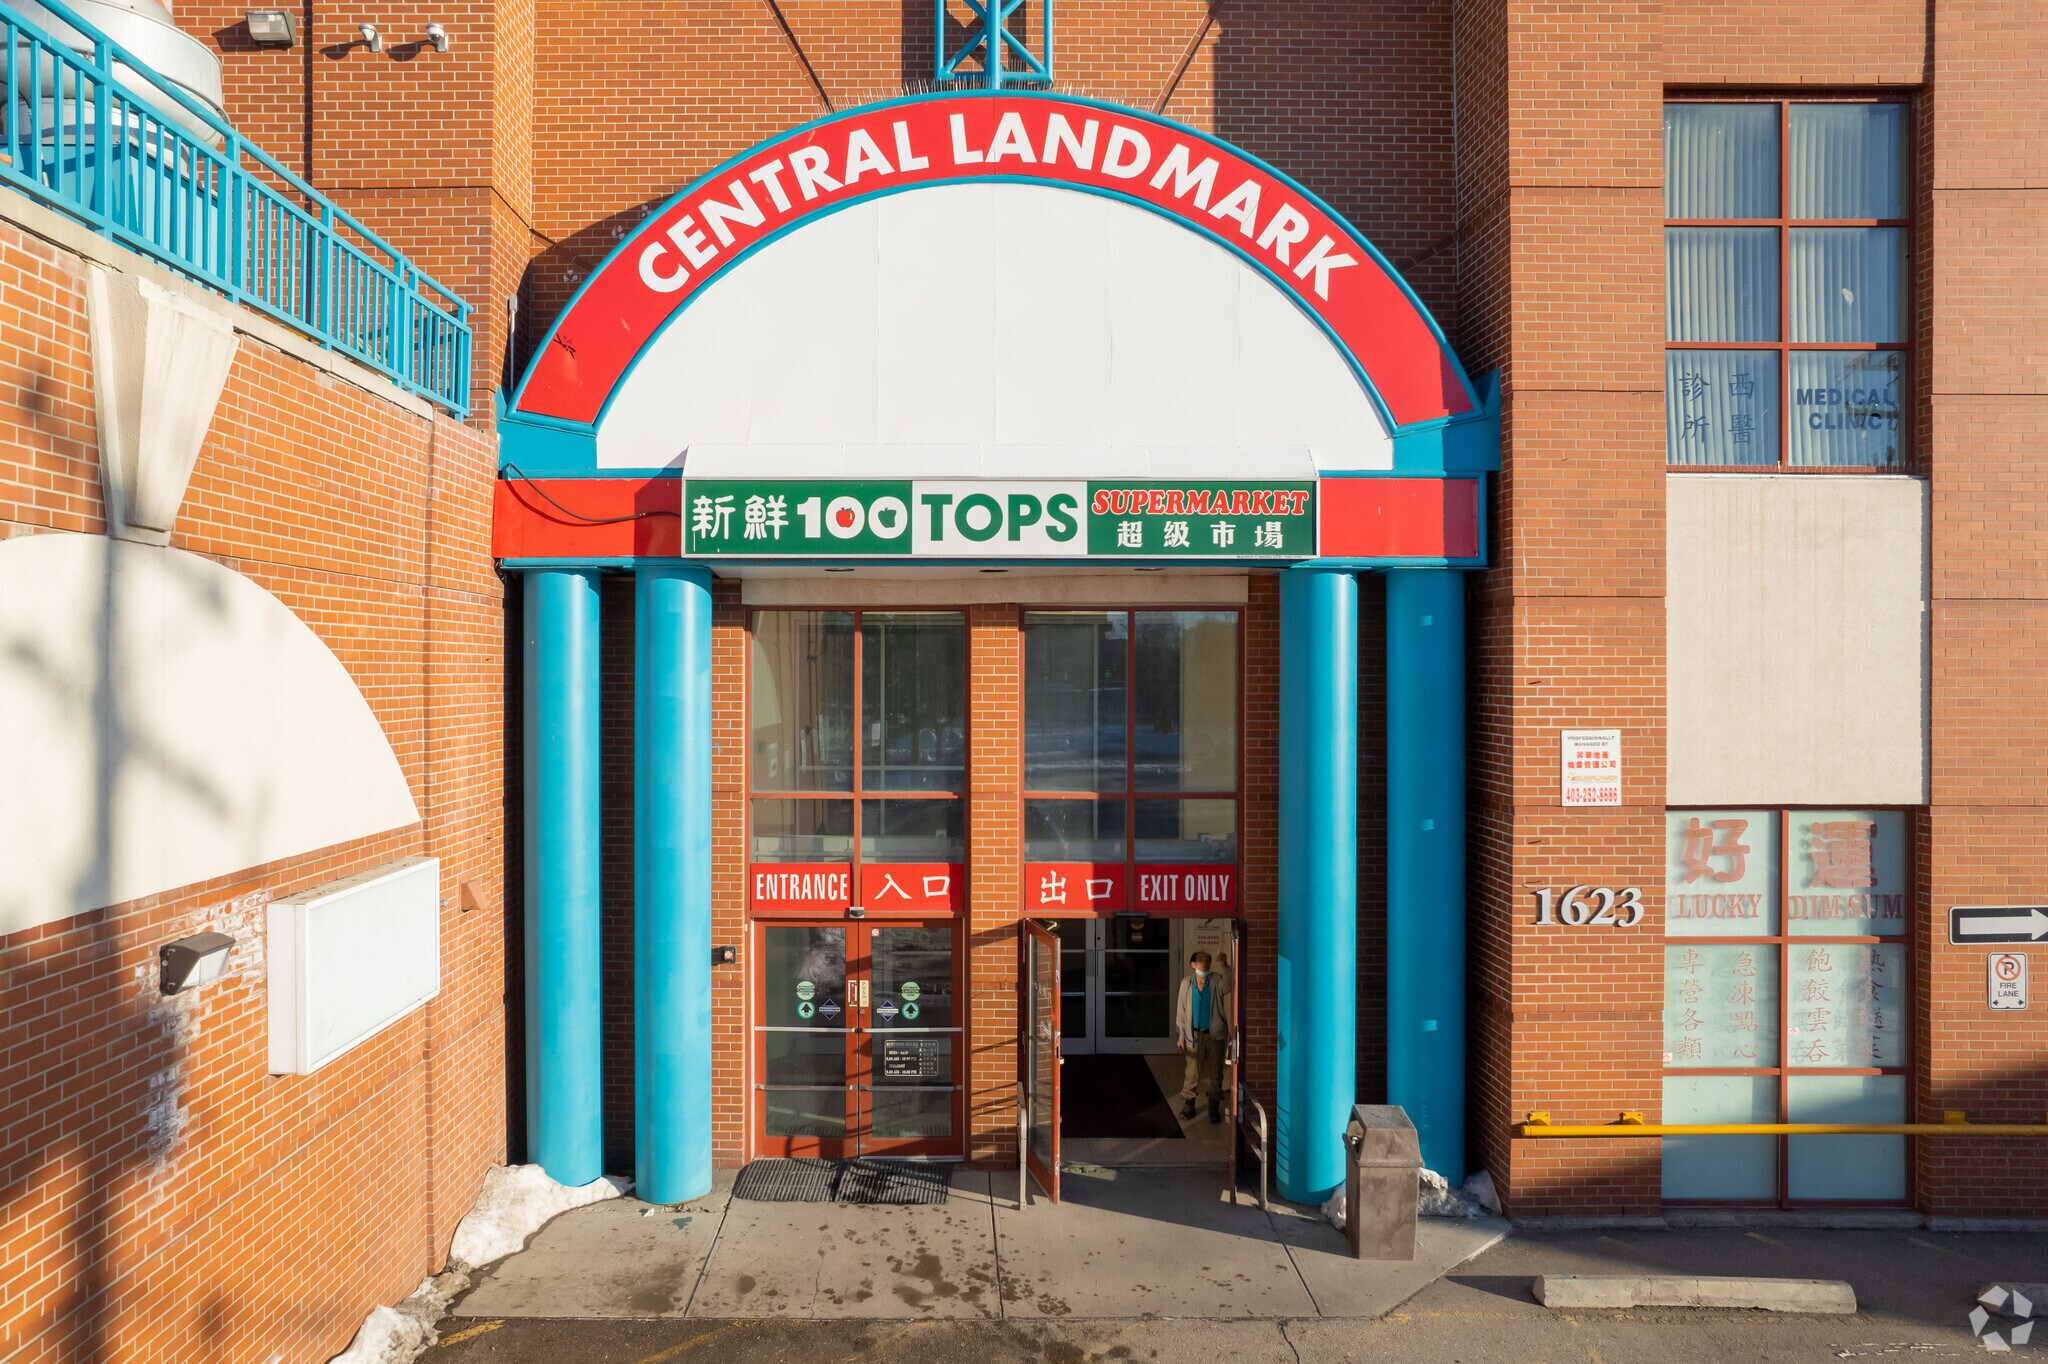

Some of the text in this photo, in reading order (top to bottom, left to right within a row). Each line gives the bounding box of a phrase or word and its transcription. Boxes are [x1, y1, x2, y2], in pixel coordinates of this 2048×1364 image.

[638, 110, 1359, 302] CENTRAL LANDMARK
[1678, 371, 1711, 444] 診所
[1727, 371, 1756, 445] 西醫
[1796, 388, 1896, 406] MEDICAL
[1808, 412, 1882, 430] CLINIC
[1091, 489, 1310, 516] SUPERMARKET
[691, 494, 790, 541] 新鮮
[796, 495, 909, 540] 100
[920, 492, 1079, 543] TOPS
[1116, 520, 1284, 549] 超級市場
[756, 873, 848, 900] ENTRANCE
[873, 873, 951, 900] 入口
[1040, 869, 1114, 905] 出口
[1140, 874, 1230, 902] EXIT ONLY
[1535, 884, 1645, 928] 1623
[1677, 893, 1762, 919] LUCKY
[1789, 894, 1904, 919] DIM SUM
